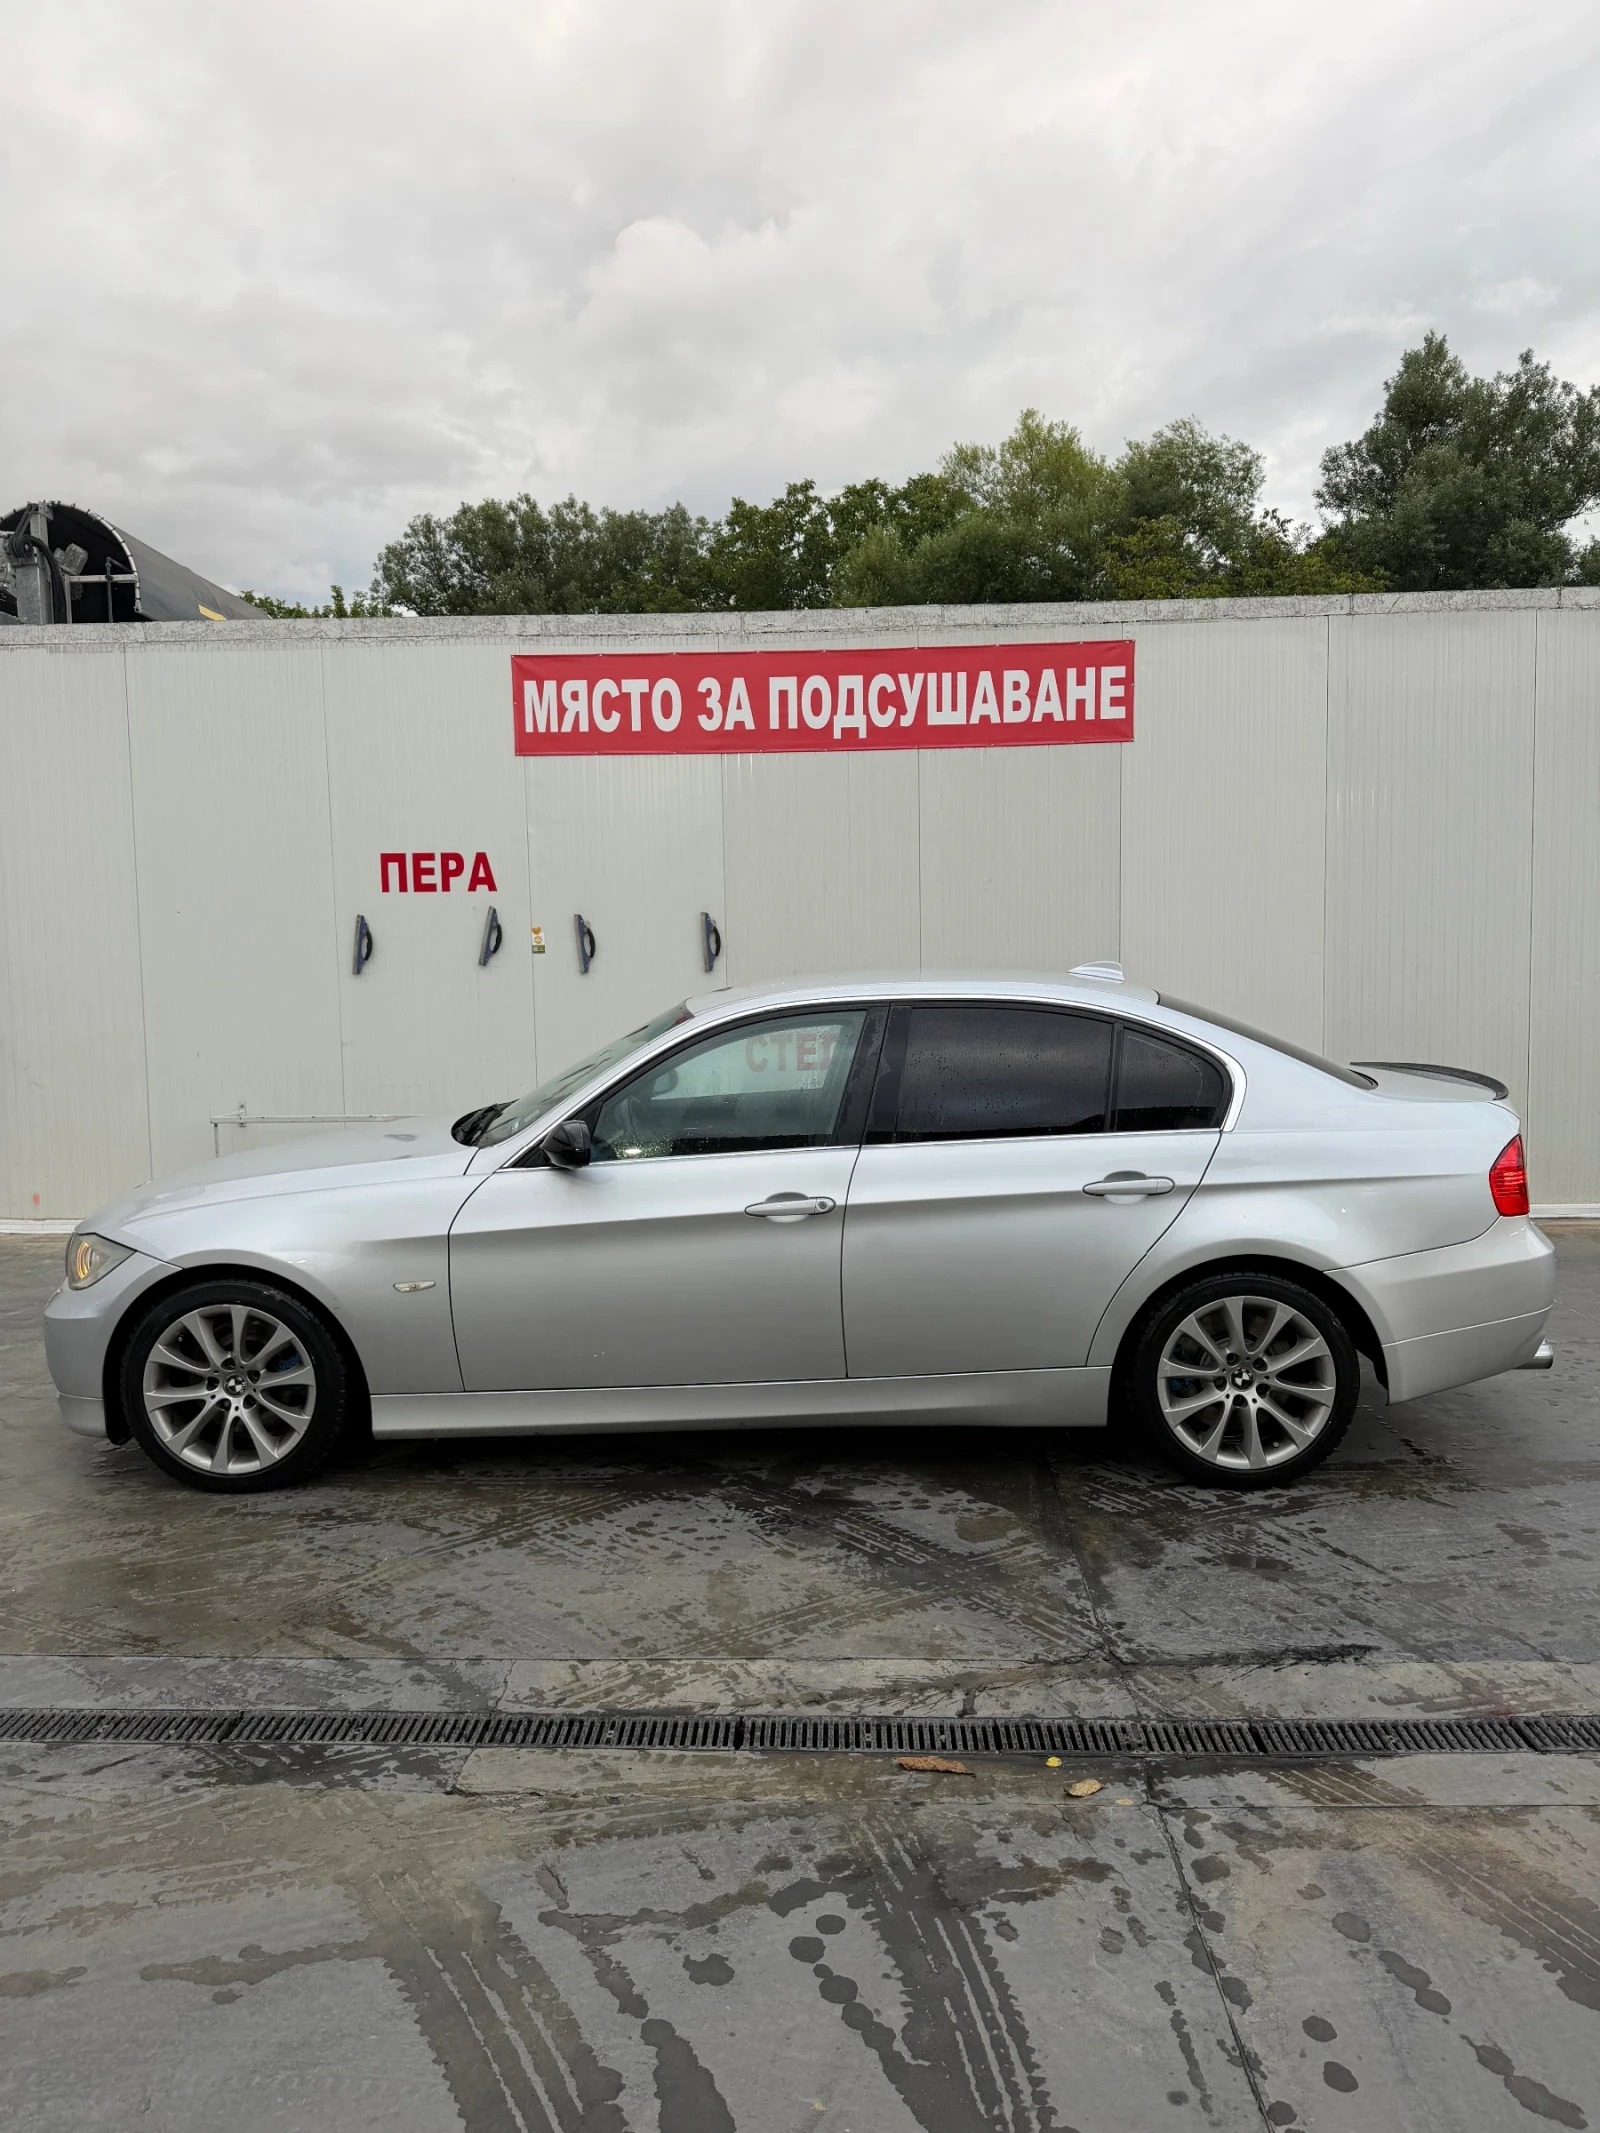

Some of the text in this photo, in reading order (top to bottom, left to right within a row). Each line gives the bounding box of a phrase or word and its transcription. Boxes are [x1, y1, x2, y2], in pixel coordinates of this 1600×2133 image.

[523, 665, 1127, 739] МЯСТО ЗА ПОДСУШАВАНЕ
[380, 851, 498, 893] ПЕРА
